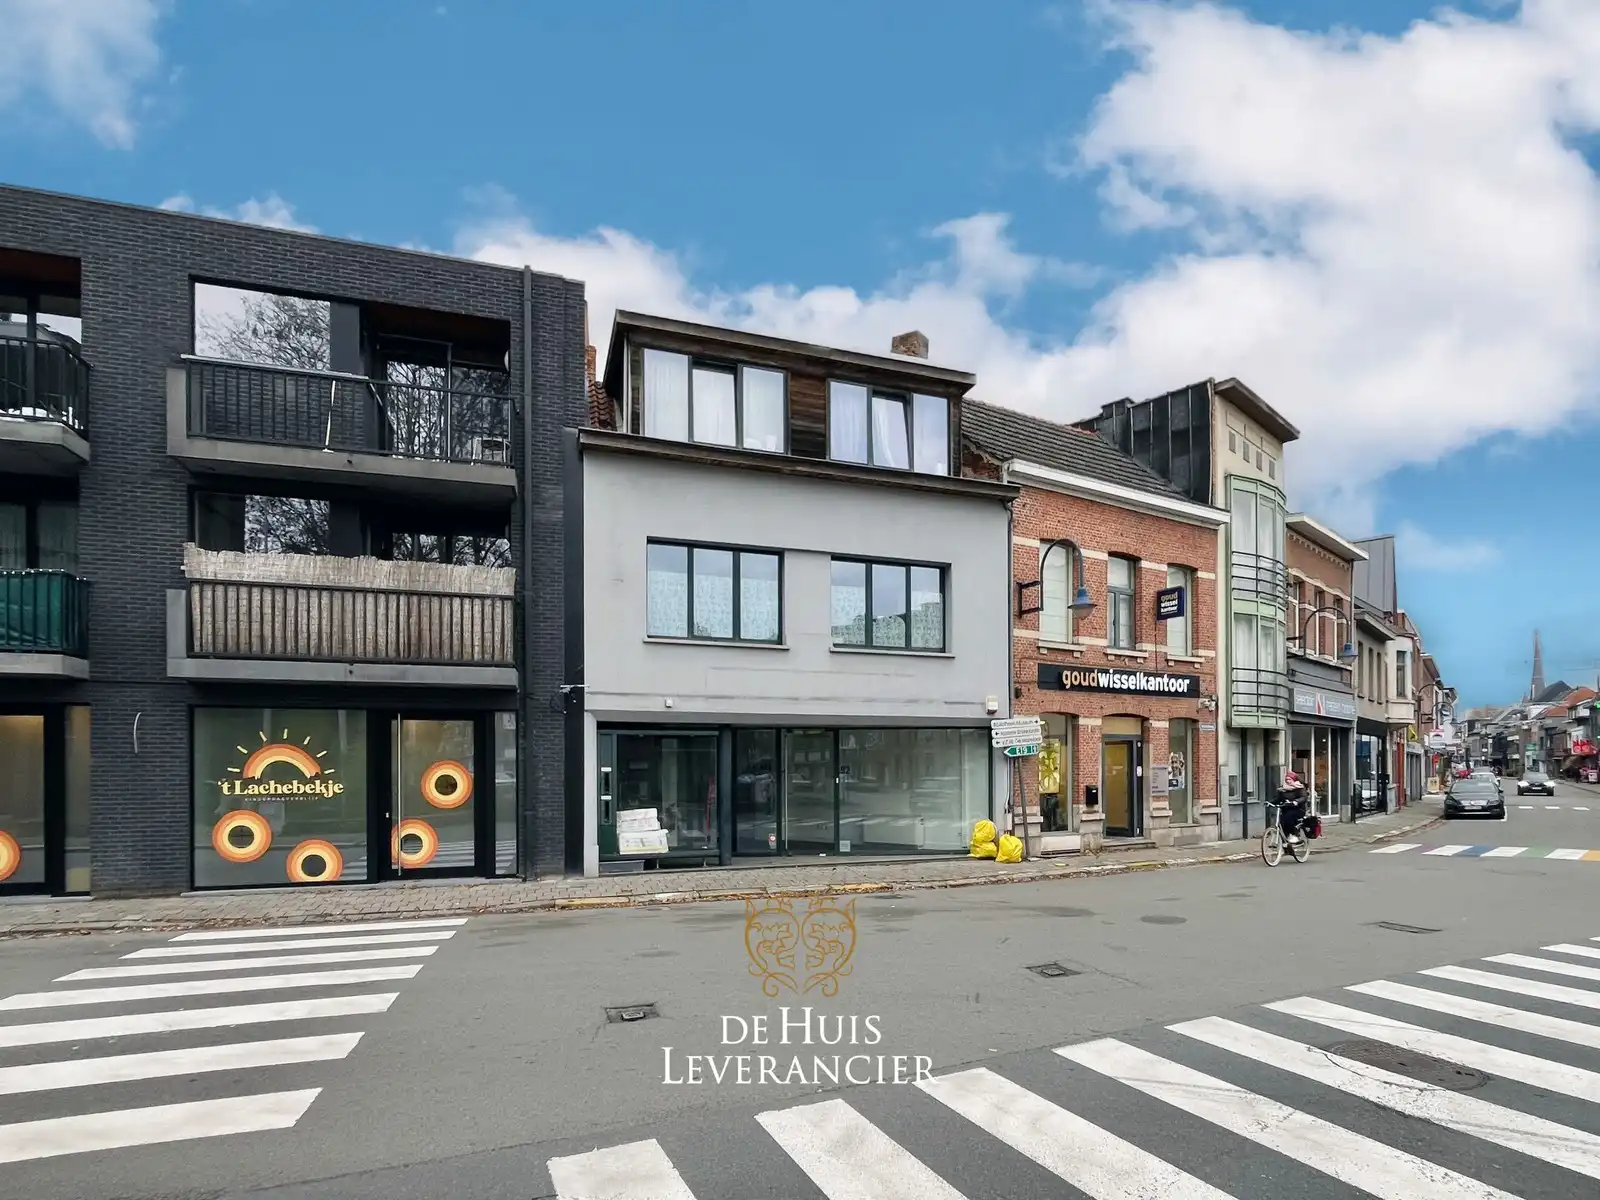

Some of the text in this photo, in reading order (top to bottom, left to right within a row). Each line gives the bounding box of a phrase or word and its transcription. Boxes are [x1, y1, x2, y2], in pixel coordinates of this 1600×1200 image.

[1160, 591, 1178, 602] goud
[1160, 599, 1178, 608] wissel
[1062, 668, 1190, 694] goudwisselkantoor
[234, 779, 344, 797] Lachebekje
